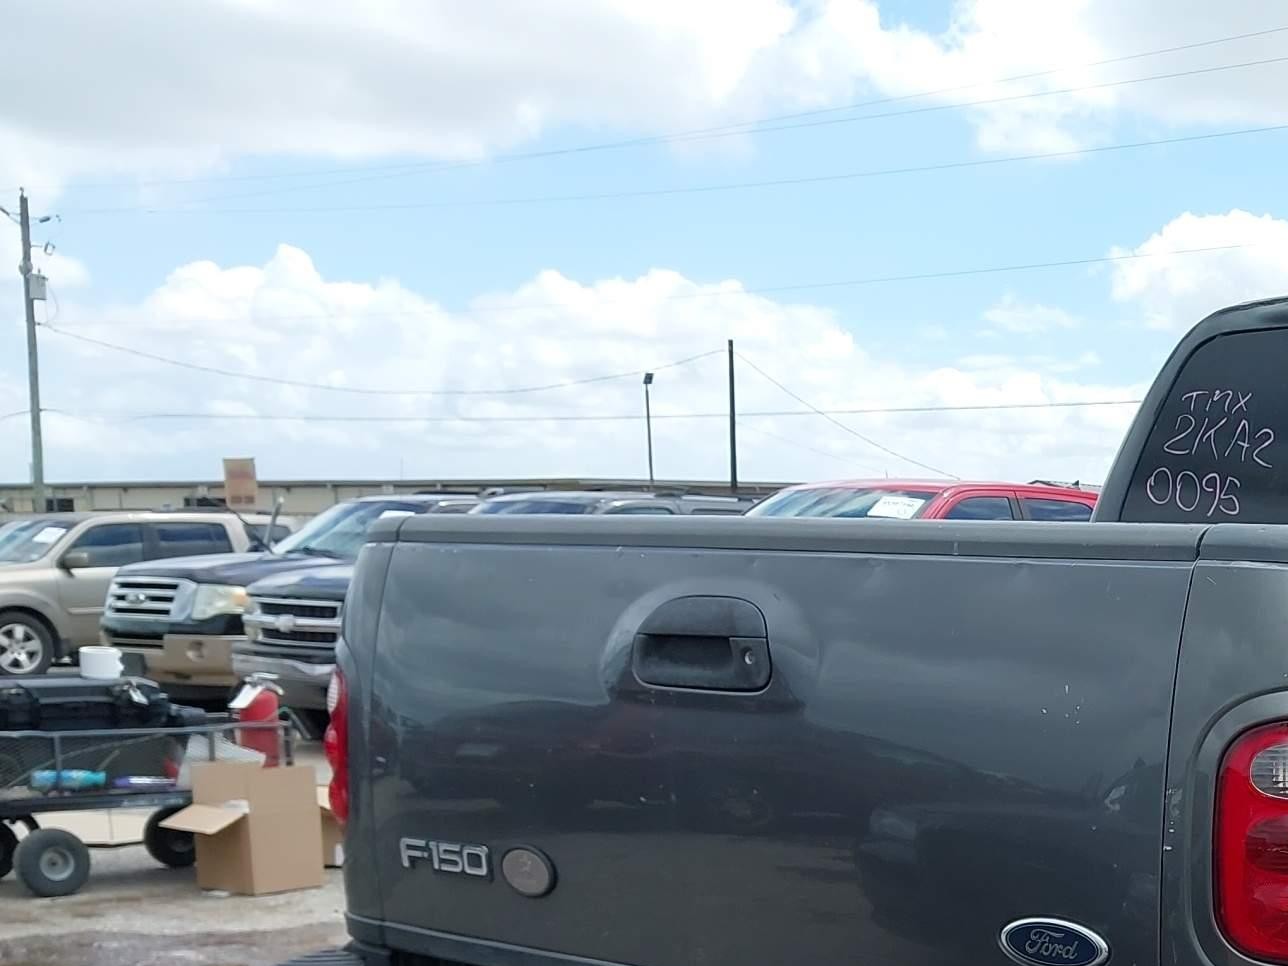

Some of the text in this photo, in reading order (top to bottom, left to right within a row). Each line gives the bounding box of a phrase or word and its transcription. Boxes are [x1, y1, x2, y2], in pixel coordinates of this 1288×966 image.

[1163, 414, 1275, 469] 2KA2
[1146, 466, 1242, 517] 0095
[1025, 928, 1079, 960] Ford
